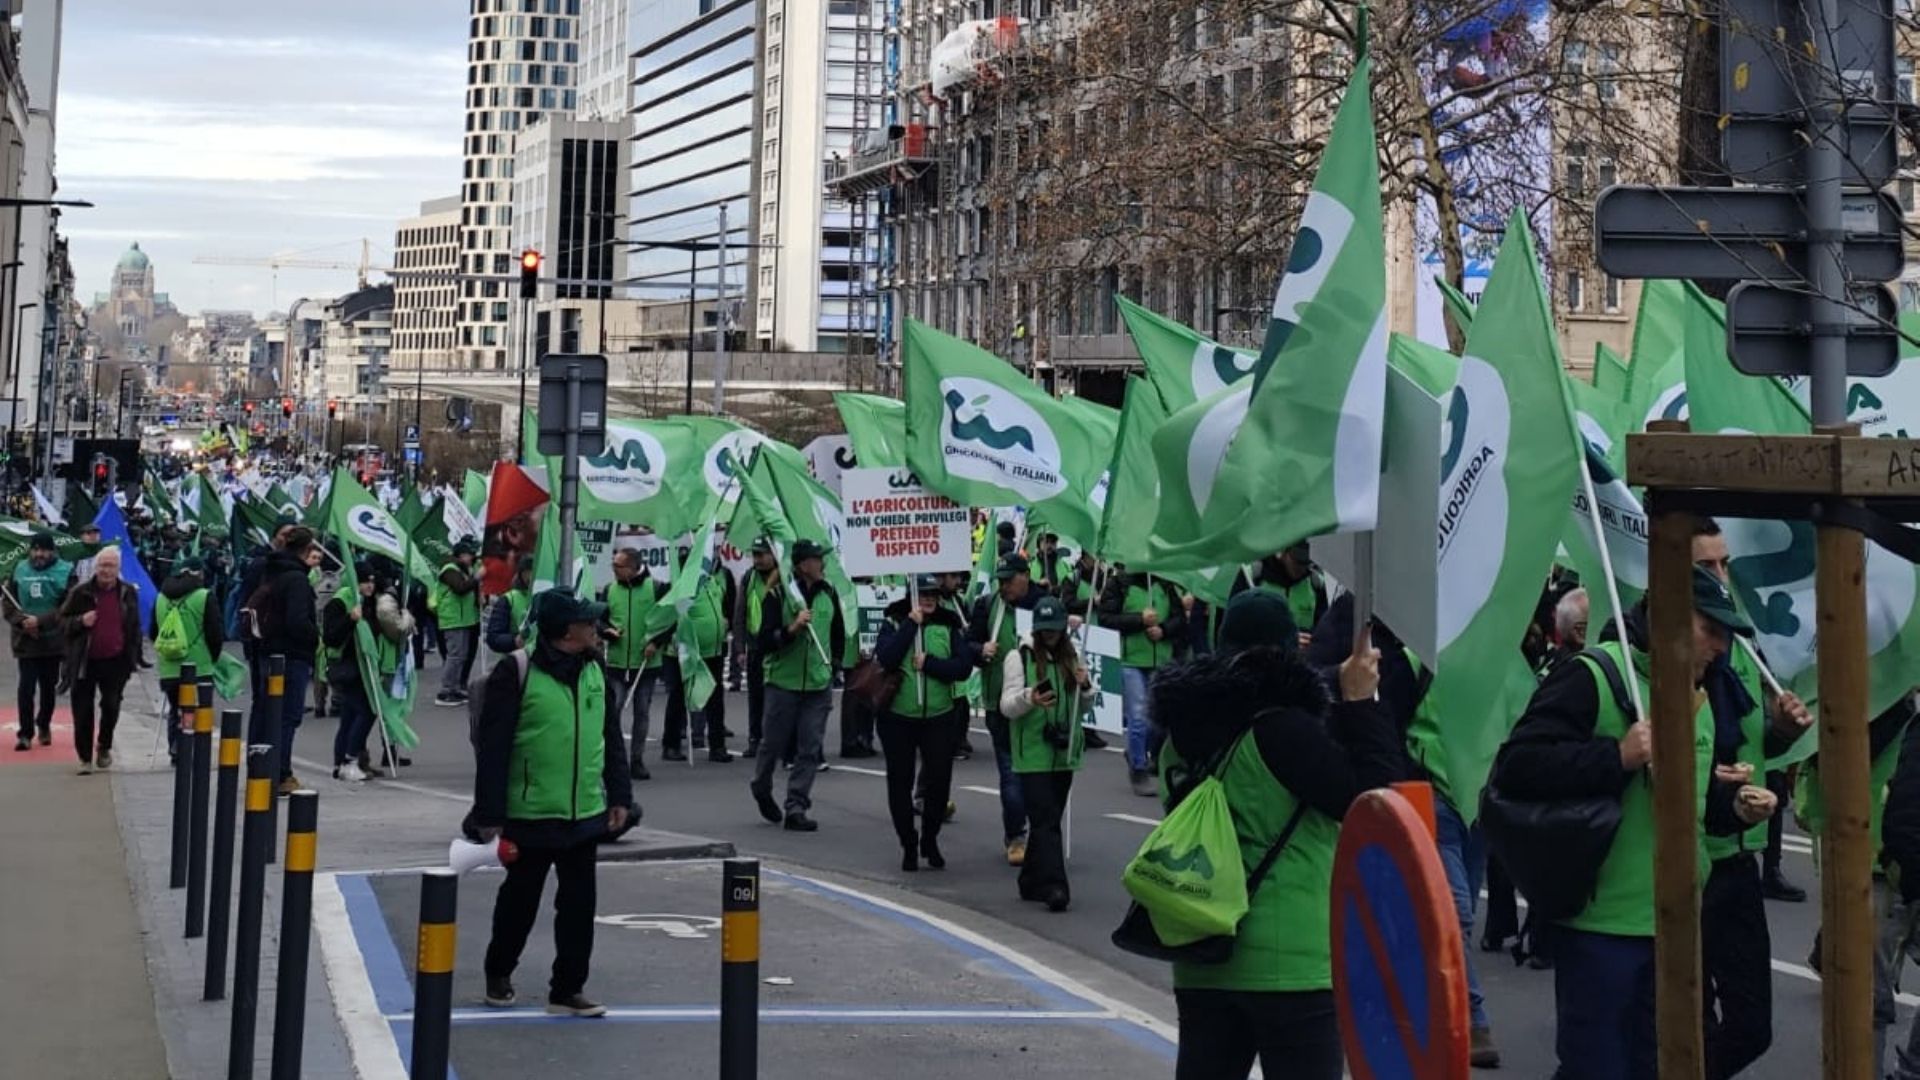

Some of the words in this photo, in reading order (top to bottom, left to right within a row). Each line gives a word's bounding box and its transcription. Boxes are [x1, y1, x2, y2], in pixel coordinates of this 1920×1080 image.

[846, 516, 871, 528] NON
[874, 513, 911, 527] CHIEDE
[915, 511, 968, 524] PRIVILEGI
[870, 525, 940, 541] PRETENDE
[875, 540, 940, 557] RISPETTO
